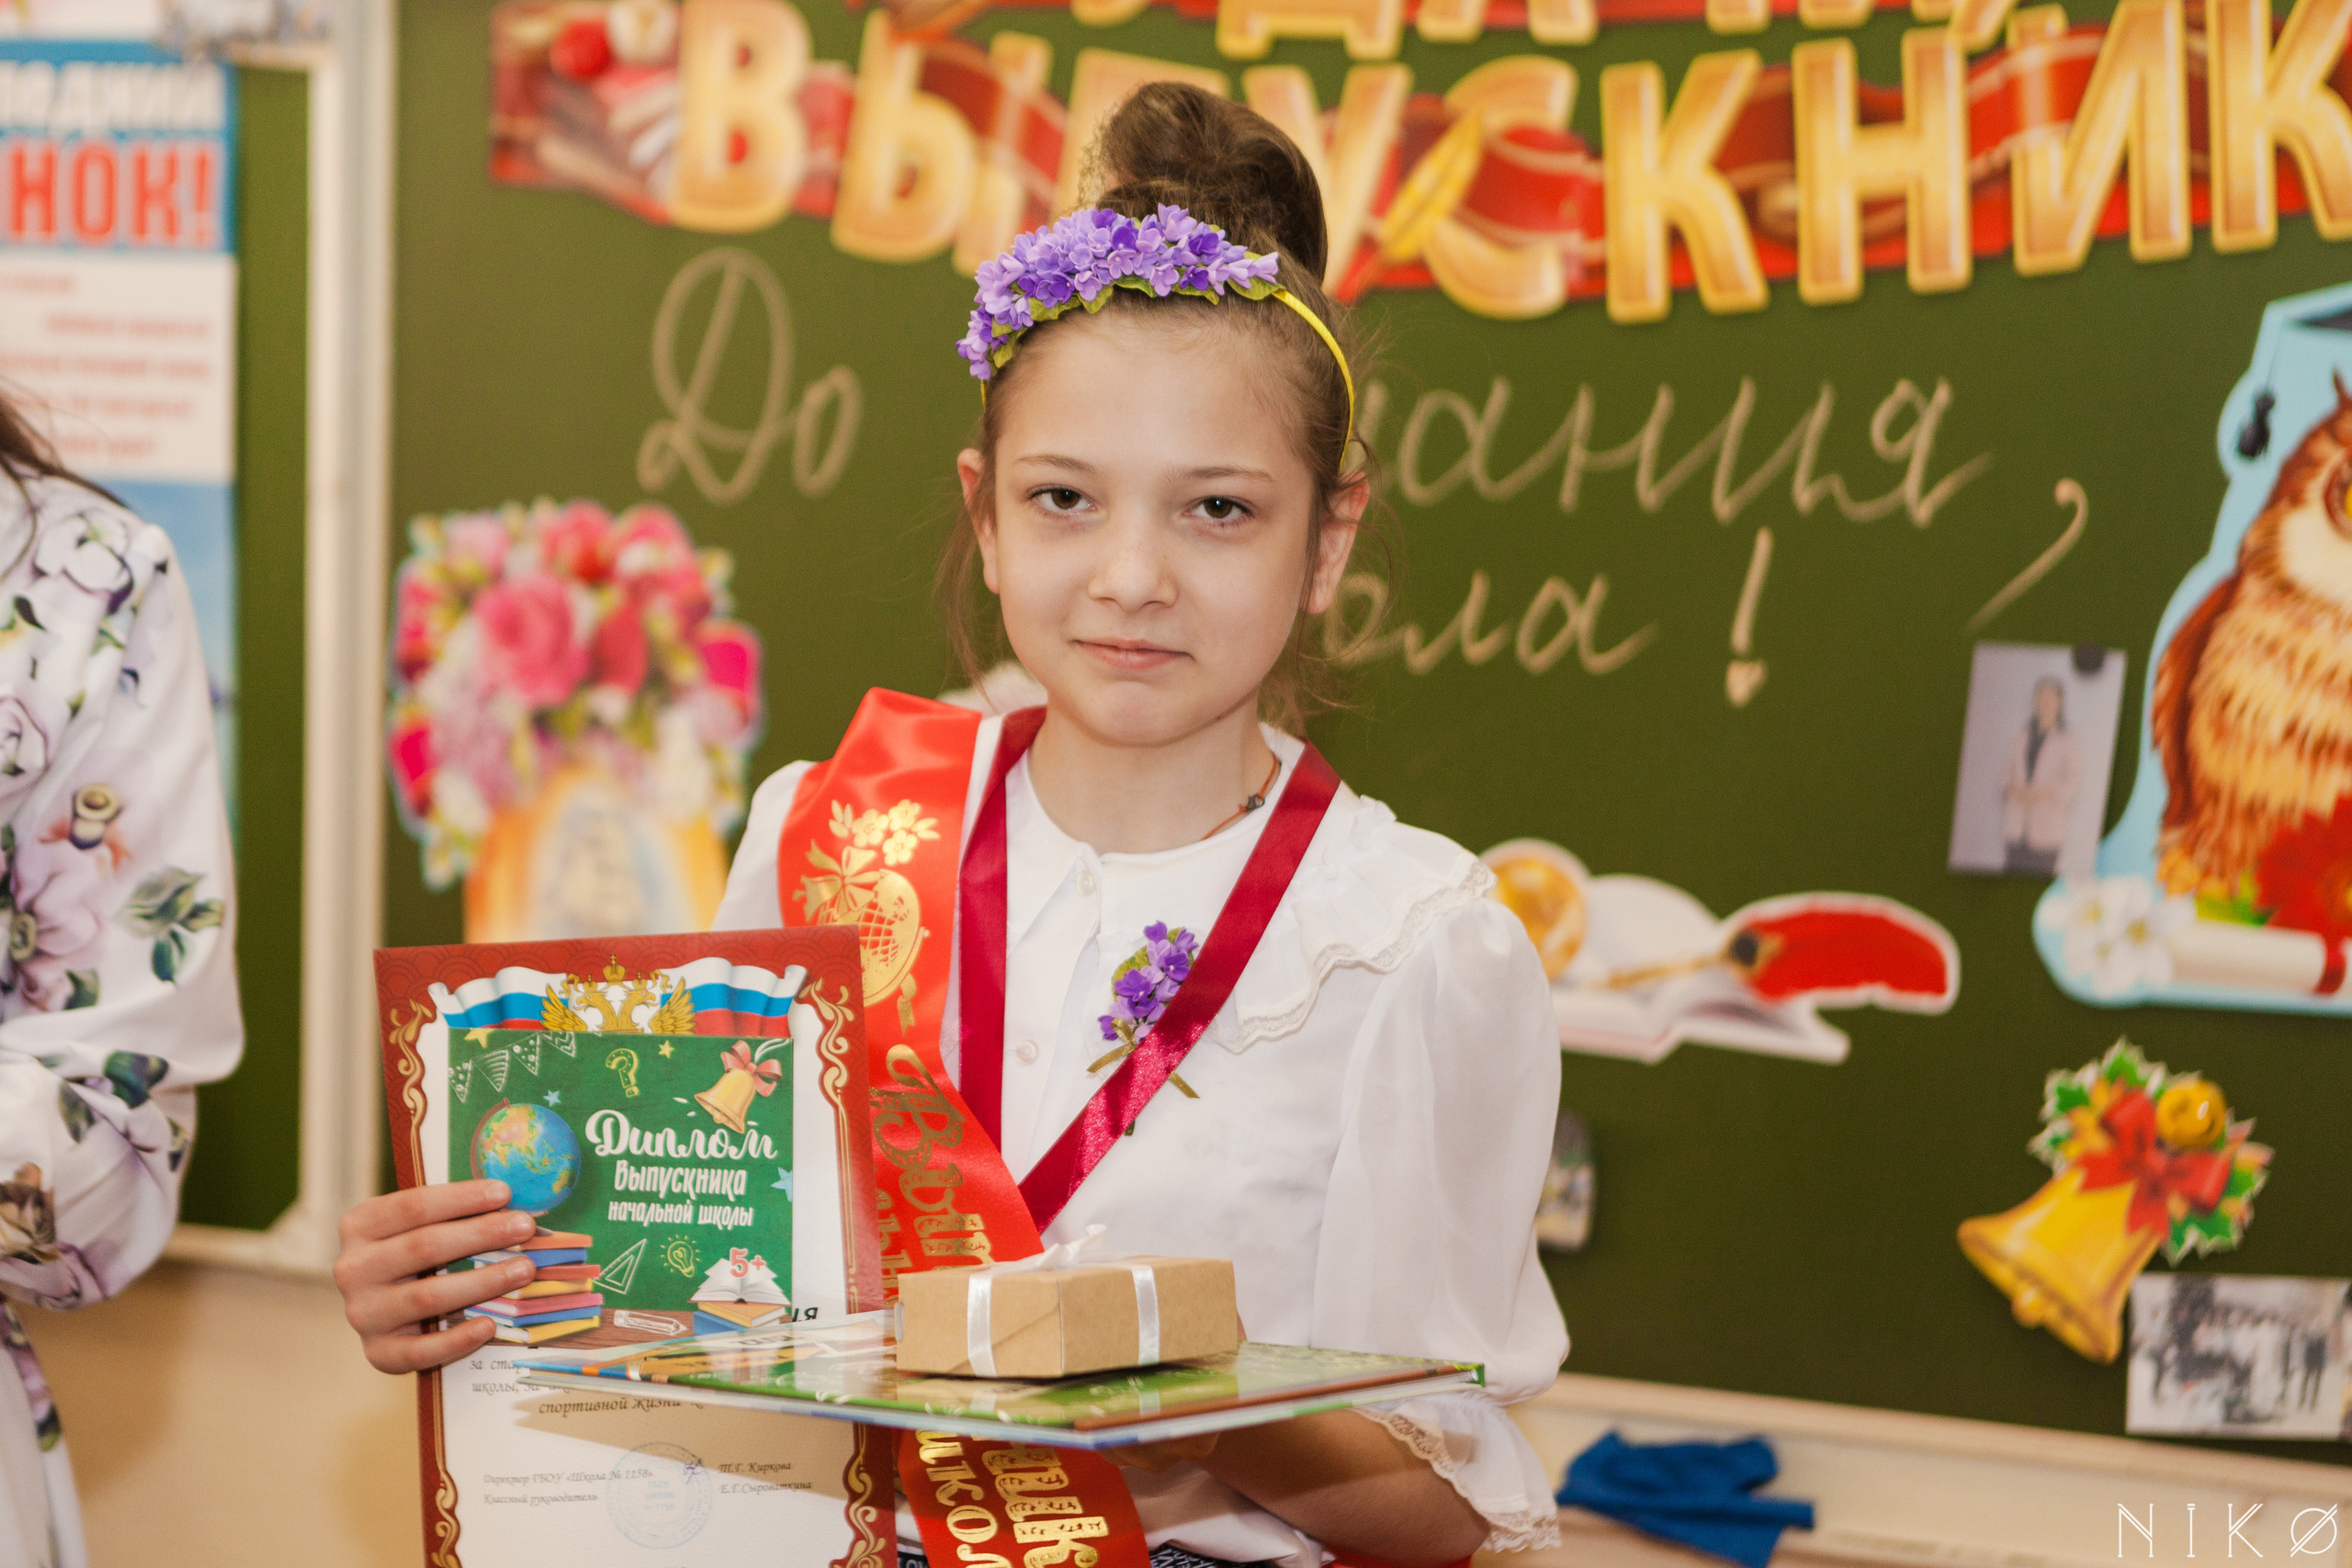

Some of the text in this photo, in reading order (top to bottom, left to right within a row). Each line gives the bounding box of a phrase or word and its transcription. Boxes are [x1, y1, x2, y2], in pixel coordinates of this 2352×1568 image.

[637, 245, 863, 504] До
[585, 1109, 778, 1160] Диплом
[614, 1159, 747, 1201] Выпускника
[607, 1200, 753, 1231] начальной школы
[469, 1360, 482, 1371] за
[471, 1382, 519, 1396] школы,
[538, 1397, 628, 1417] спортивной
[748, 1462, 792, 1474] Киркова
[483, 1473, 529, 1486] Директор
[531, 1472, 565, 1483] ГБОУ
[483, 1493, 598, 1507] Классный руководитель
